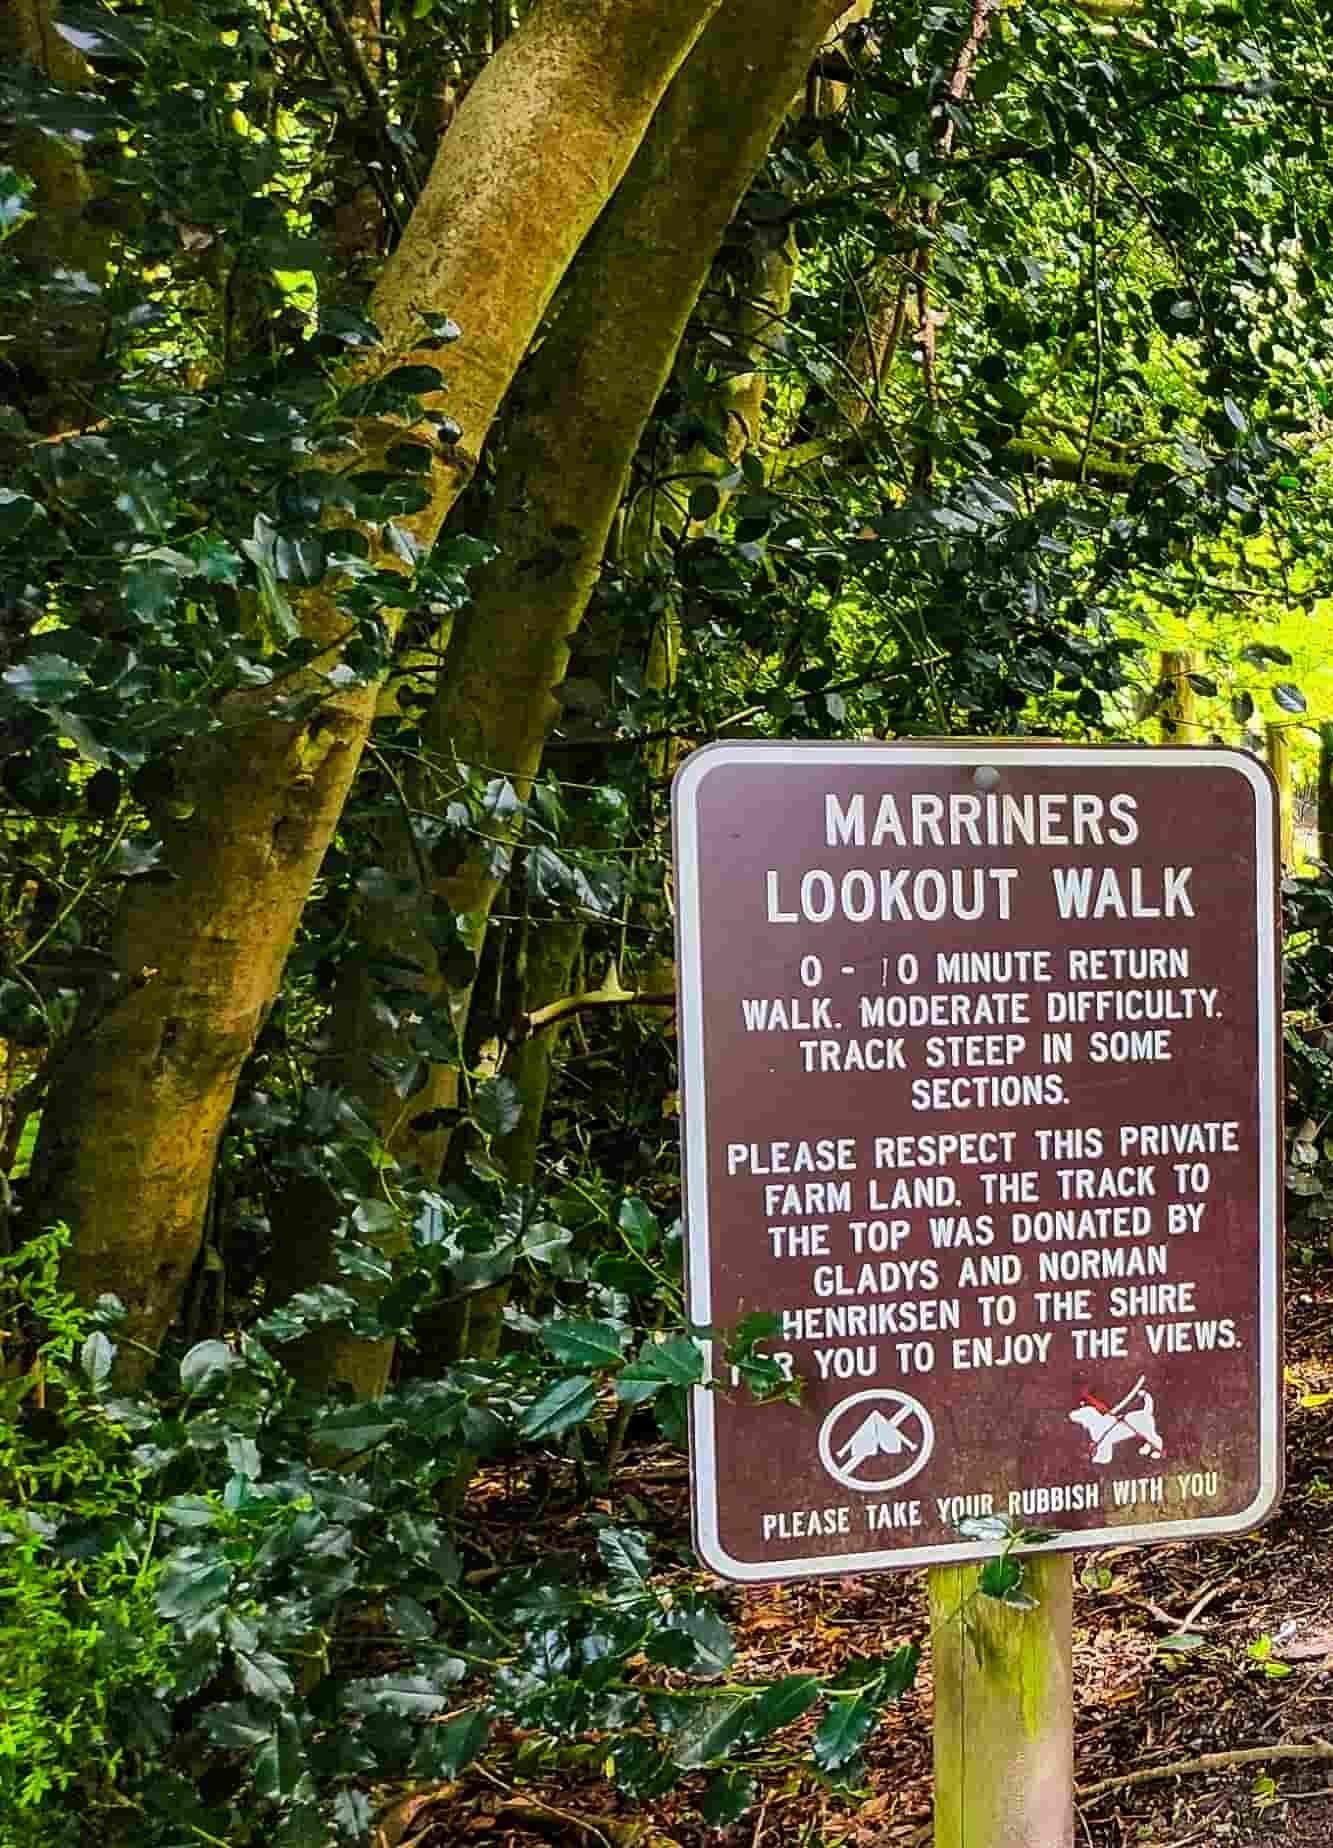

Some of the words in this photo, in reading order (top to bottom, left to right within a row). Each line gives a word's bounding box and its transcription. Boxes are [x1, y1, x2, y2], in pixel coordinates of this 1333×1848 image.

[825, 793, 1139, 847] MARRINERS
[767, 868, 1019, 923] LOOKOUT
[1052, 867, 1195, 919] WALK
[936, 951, 1052, 984] MINUTE
[1069, 948, 1189, 981] RETURN
[741, 997, 842, 1032] WALK.
[859, 992, 1030, 1028] MODERATE
[1047, 988, 1223, 1023] DIFFICULTY.
[799, 1038, 907, 1073] TRACK
[926, 1034, 1026, 1068] STEEP
[1043, 1032, 1073, 1064] IN
[1089, 1029, 1172, 1062] SOME
[911, 1074, 1070, 1111] SECTIONS.
[727, 1138, 857, 1176] PLEASE
[874, 1131, 1017, 1169] RESPECT
[1034, 1127, 1103, 1161] THIS
[1120, 1121, 1239, 1157] PRIVATE
[765, 1181, 851, 1217] FARM
[869, 1176, 962, 1211] LAND.
[979, 1171, 1039, 1204] THE
[1056, 1165, 1156, 1201] TRACK
[1173, 1162, 1210, 1194] TO
[767, 1224, 831, 1258] THE
[848, 1220, 911, 1253] TOP
[929, 1215, 995, 1249] WAS
[1012, 1206, 1152, 1242] DONATED
[1167, 1202, 1206, 1234] BY
[813, 1264, 939, 1298] GLADYS
[958, 1254, 1022, 1288] AND
[1038, 1245, 1168, 1283] NORMAN
[782, 1299, 960, 1341] HENRIKSEN
[977, 1294, 1017, 1327] TO
[1033, 1289, 1092, 1323] THE
[1109, 1282, 1196, 1318] SHIRE
[813, 1345, 877, 1380] YOU
[895, 1341, 935, 1374] TO
[952, 1332, 1053, 1370] ENJOY
[1071, 1326, 1129, 1360] THE
[1145, 1318, 1242, 1354] VIEWS.
[763, 1507, 850, 1540] PLEASE
[865, 1500, 922, 1530] TAKE
[936, 1493, 993, 1522] YOUR
[1008, 1483, 1099, 1516] RUBBISH
[1112, 1476, 1164, 1506] WITH
[1176, 1471, 1218, 1501] YOU
